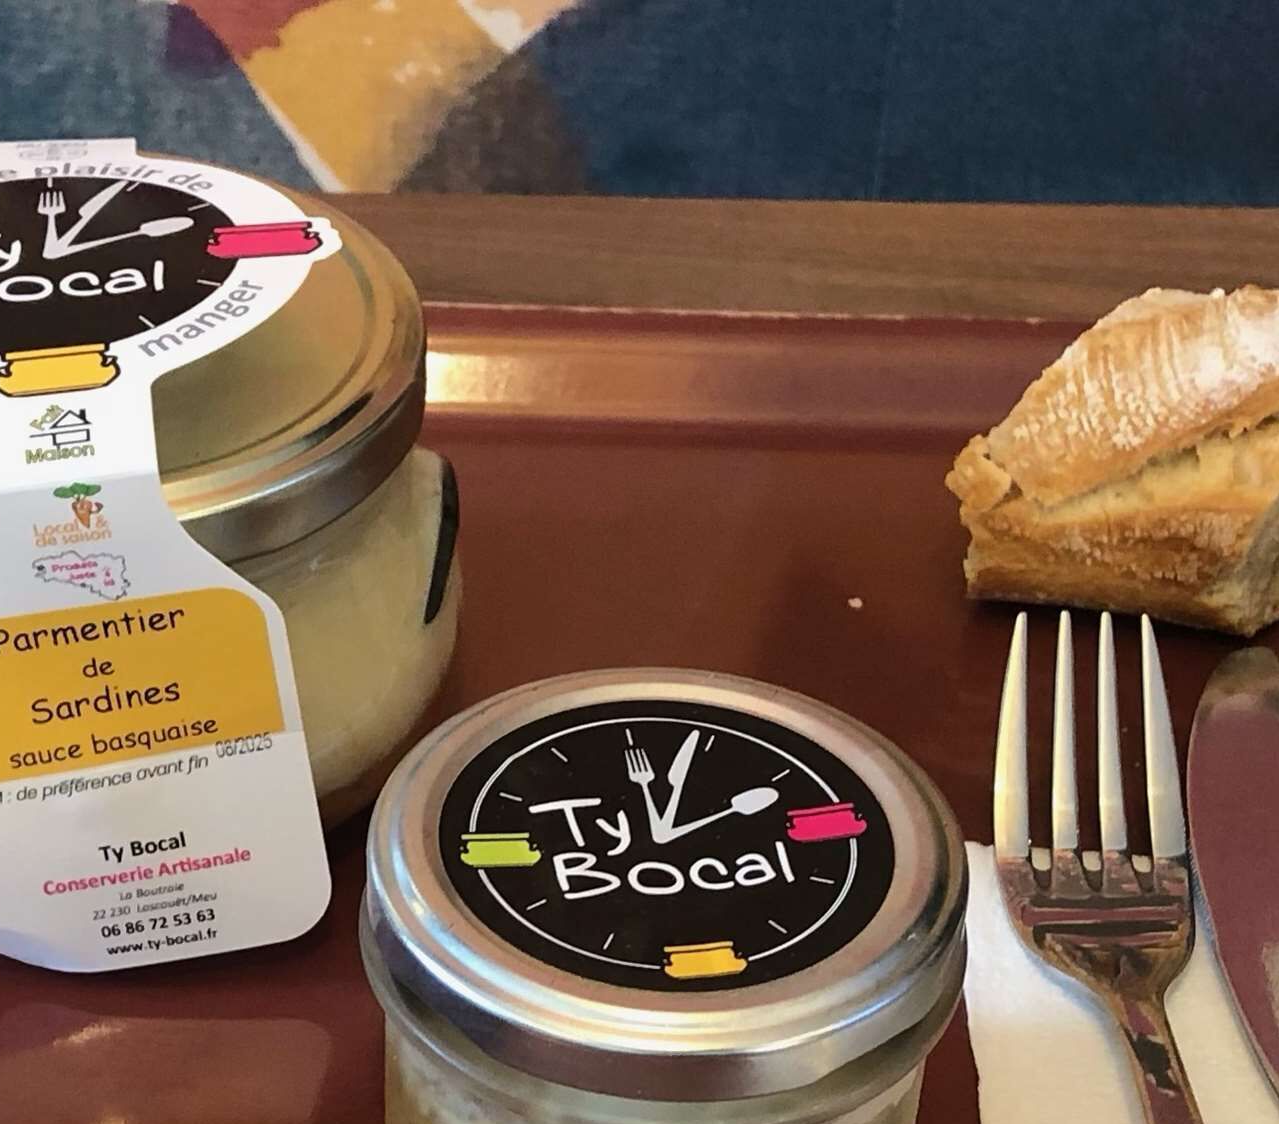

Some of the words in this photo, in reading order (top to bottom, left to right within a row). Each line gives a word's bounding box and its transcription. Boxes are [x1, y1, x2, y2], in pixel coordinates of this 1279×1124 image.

[34, 162, 164, 182] plaisir
[167, 172, 214, 194] de
[136, 278, 264, 360] manger
[25, 444, 96, 464] Maison
[33, 519, 79, 537] Local
[35, 535, 57, 548] de
[63, 528, 113, 544] saison
[82, 657, 115, 679] de
[31, 680, 181, 724] Sardines
[9, 742, 83, 769] sauce
[91, 715, 219, 755] basquaise
[16, 785, 38, 802] de
[136, 760, 184, 780] avant
[187, 755, 209, 774] fin
[528, 797, 631, 857] Ty
[98, 846, 123, 863] Ty
[130, 831, 186, 857] Bocal
[43, 866, 153, 896] Conserverie
[159, 848, 252, 877] Artisanale
[552, 840, 796, 901] Bocal
[92, 909, 106, 920] 22
[110, 906, 132, 918] 230
[101, 924, 121, 938] 06
[125, 920, 145, 935] 86
[149, 917, 169, 931] 72
[173, 913, 192, 926] 53
[196, 908, 216, 923] 63
[106, 928, 218, 956] www.ty-bocal.fr
